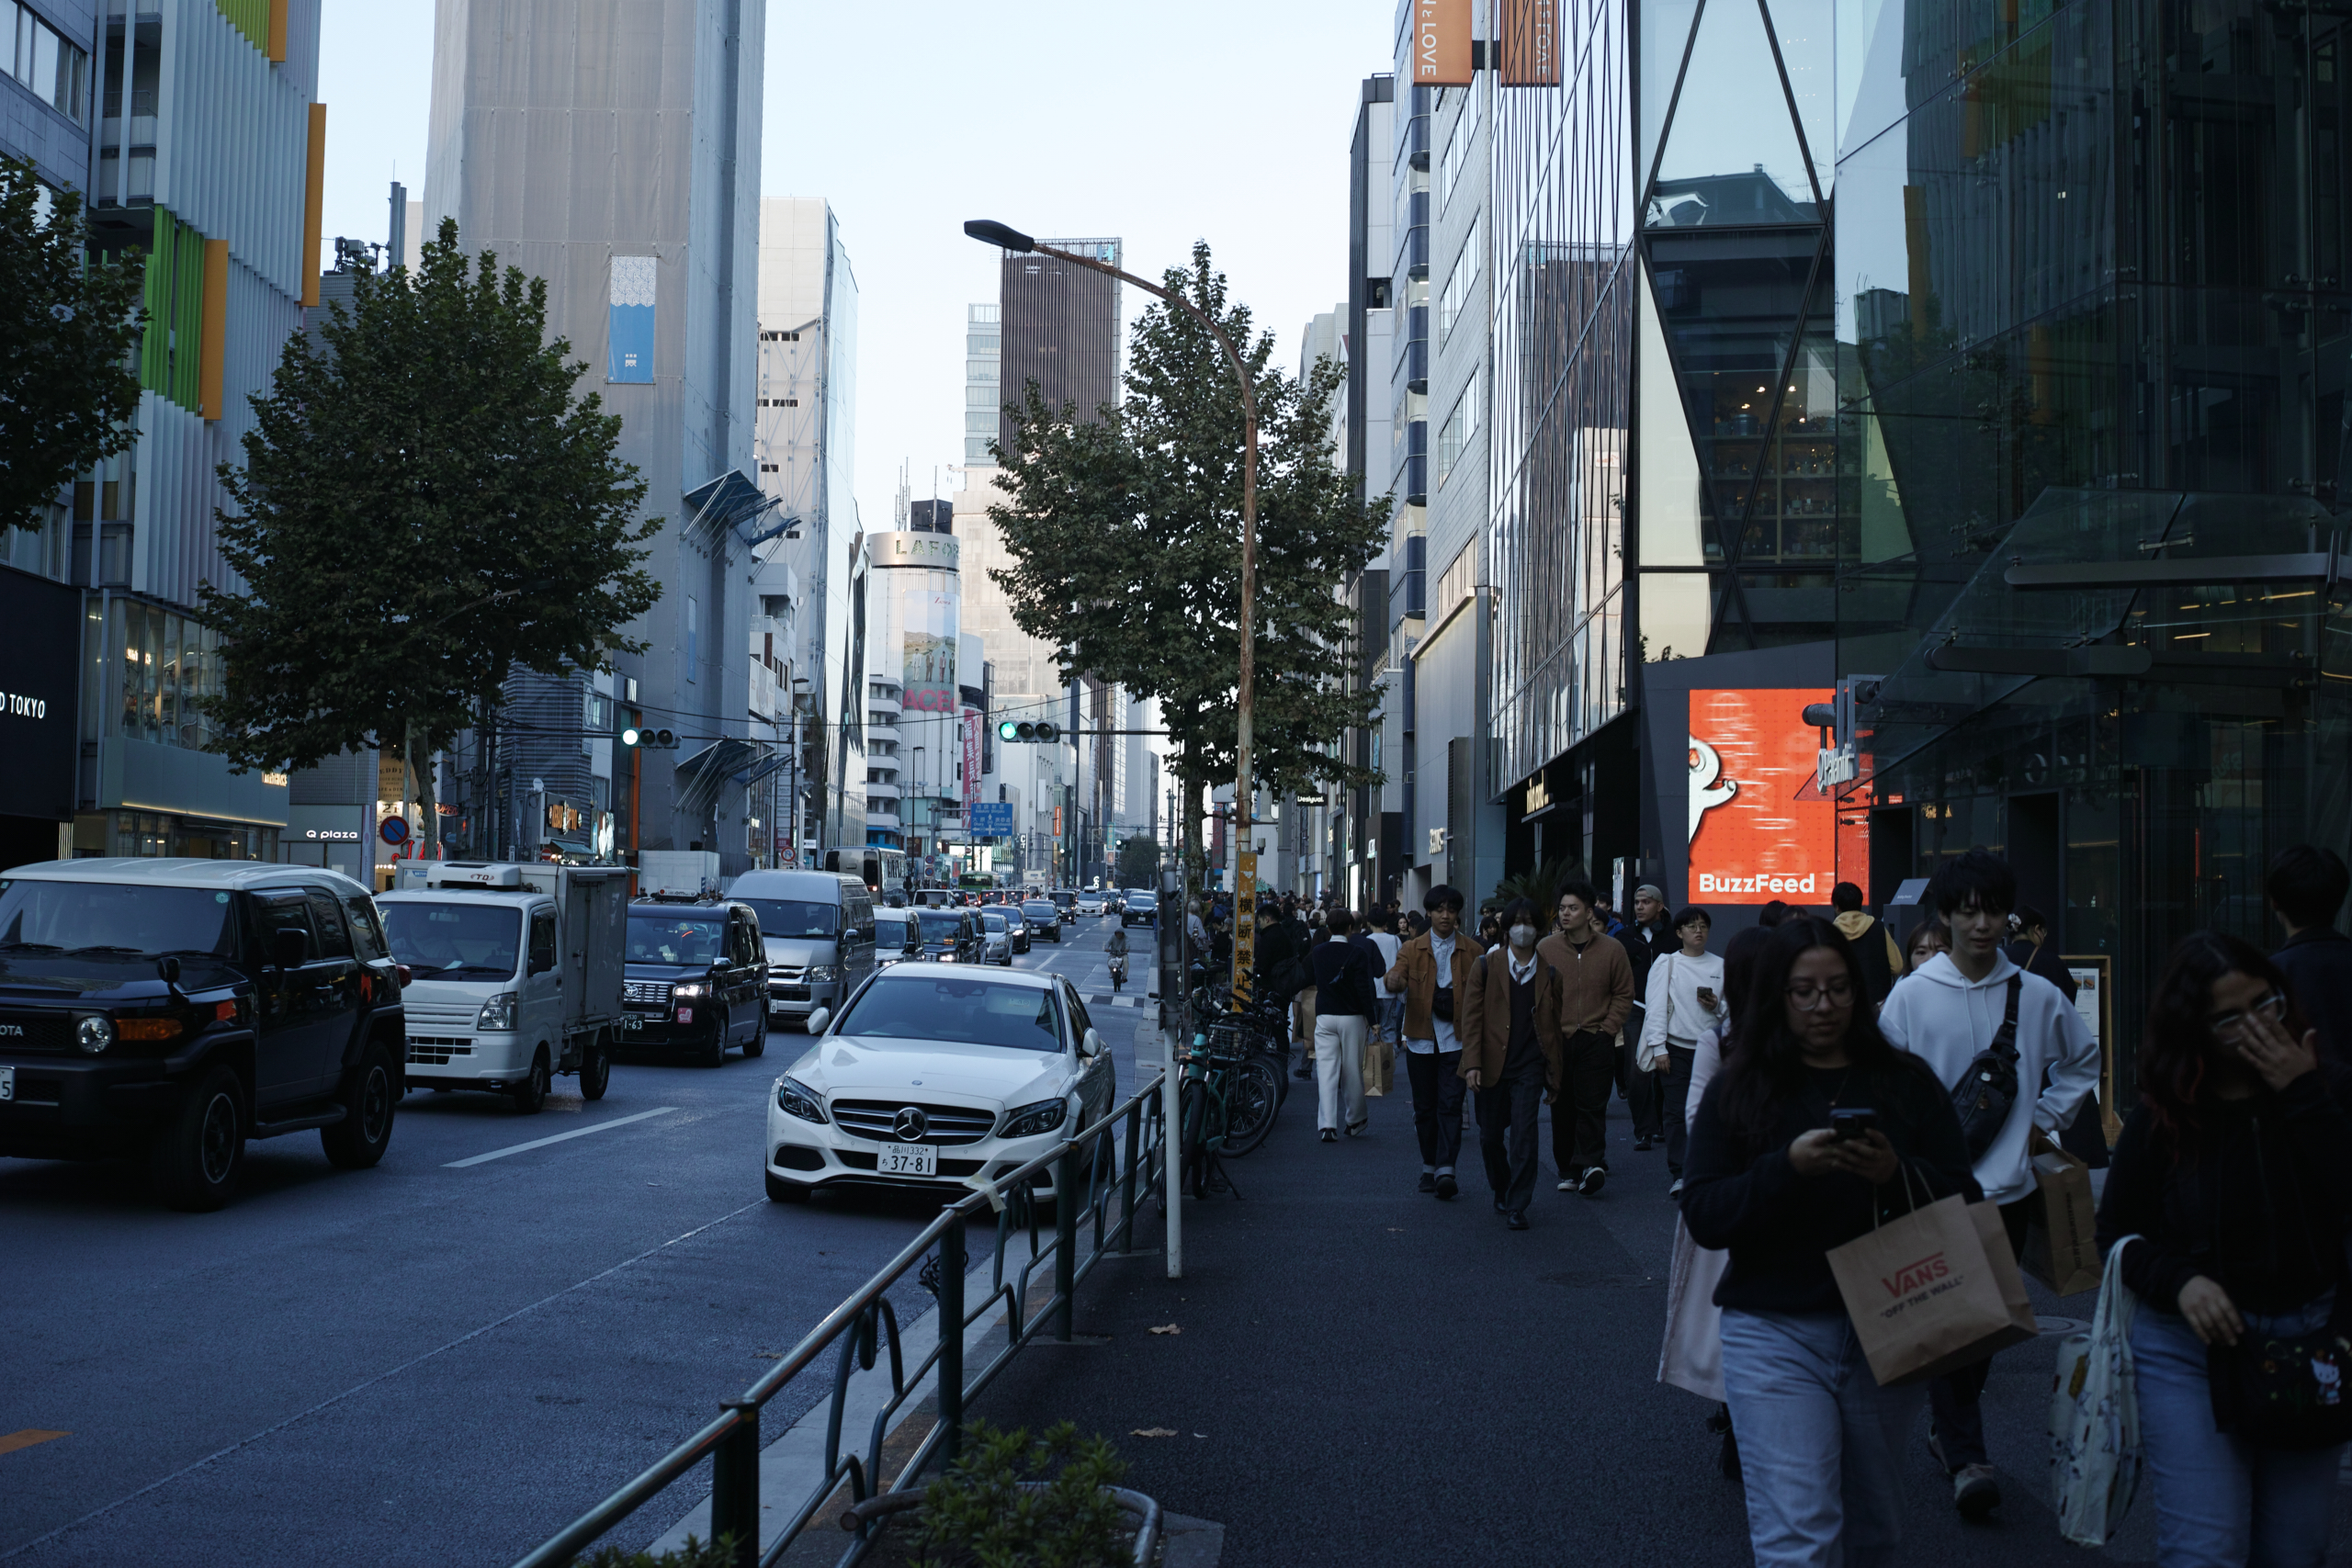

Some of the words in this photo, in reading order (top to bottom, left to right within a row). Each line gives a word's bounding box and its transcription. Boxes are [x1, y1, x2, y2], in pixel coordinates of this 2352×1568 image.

[1421, 23, 1437, 76] LOVE
[896, 539, 961, 560] LAFOR
[9, 694, 46, 719] TOKYO
[306, 829, 317, 840] Q
[320, 829, 358, 841] plaza
[1699, 874, 1815, 893] BuzzFeed
[1237, 897, 1254, 988] 横断禁止
[881, 1158, 888, 1167] ち
[890, 1156, 932, 1173] 37-81
[1882, 1251, 1950, 1299] VANS
[1906, 1292, 1929, 1307] THE
